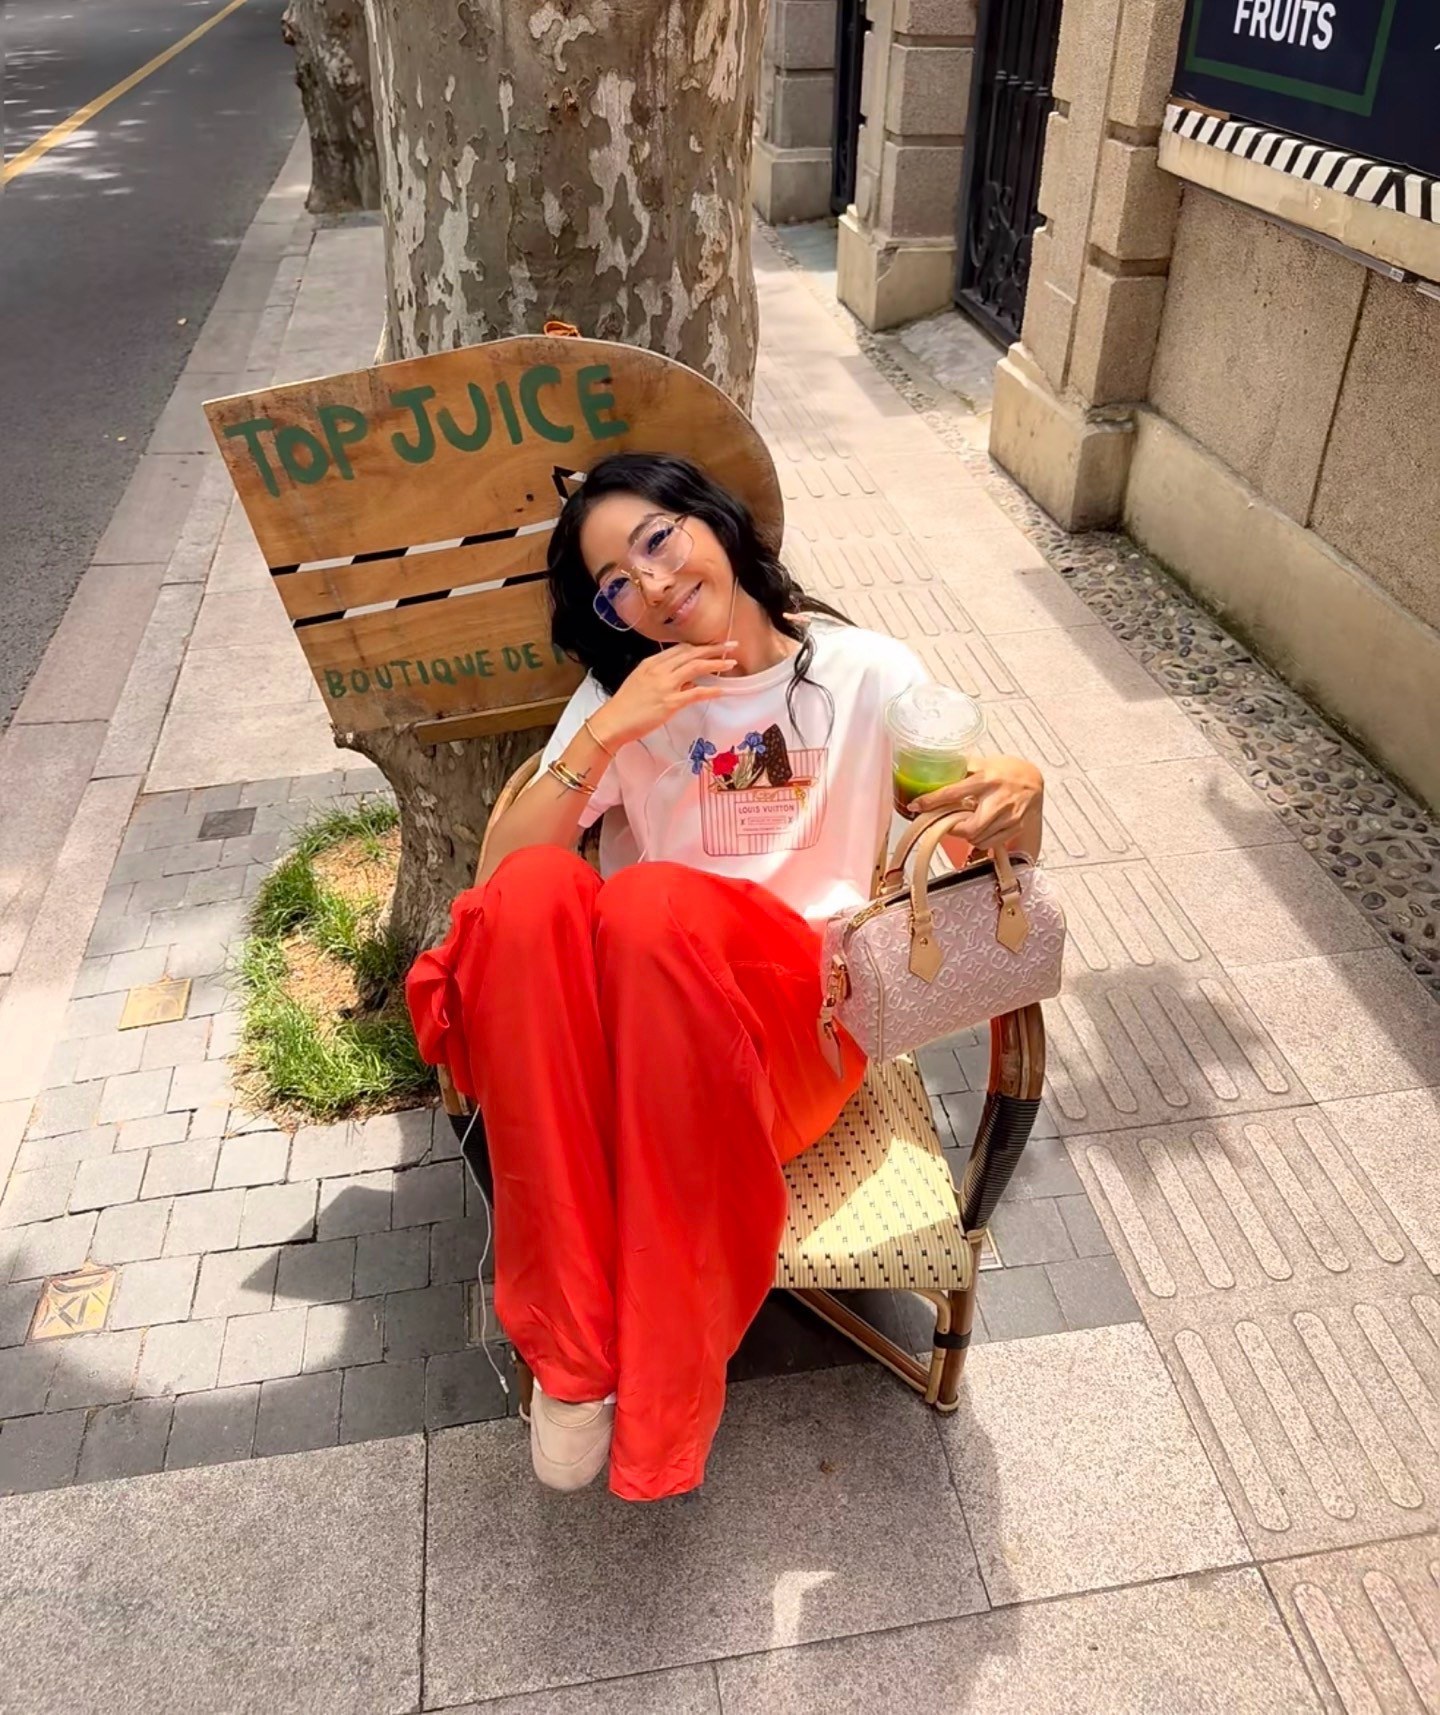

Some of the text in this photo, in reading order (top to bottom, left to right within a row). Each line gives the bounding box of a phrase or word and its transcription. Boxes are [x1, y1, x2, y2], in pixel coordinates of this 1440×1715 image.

[1233, 0, 1336, 50] FRUITS
[223, 364, 630, 498] TOP JUICE
[324, 650, 497, 698] BOUTIQUE
[500, 643, 543, 672] DE
[738, 804, 794, 814] LOUIS VUITTON
